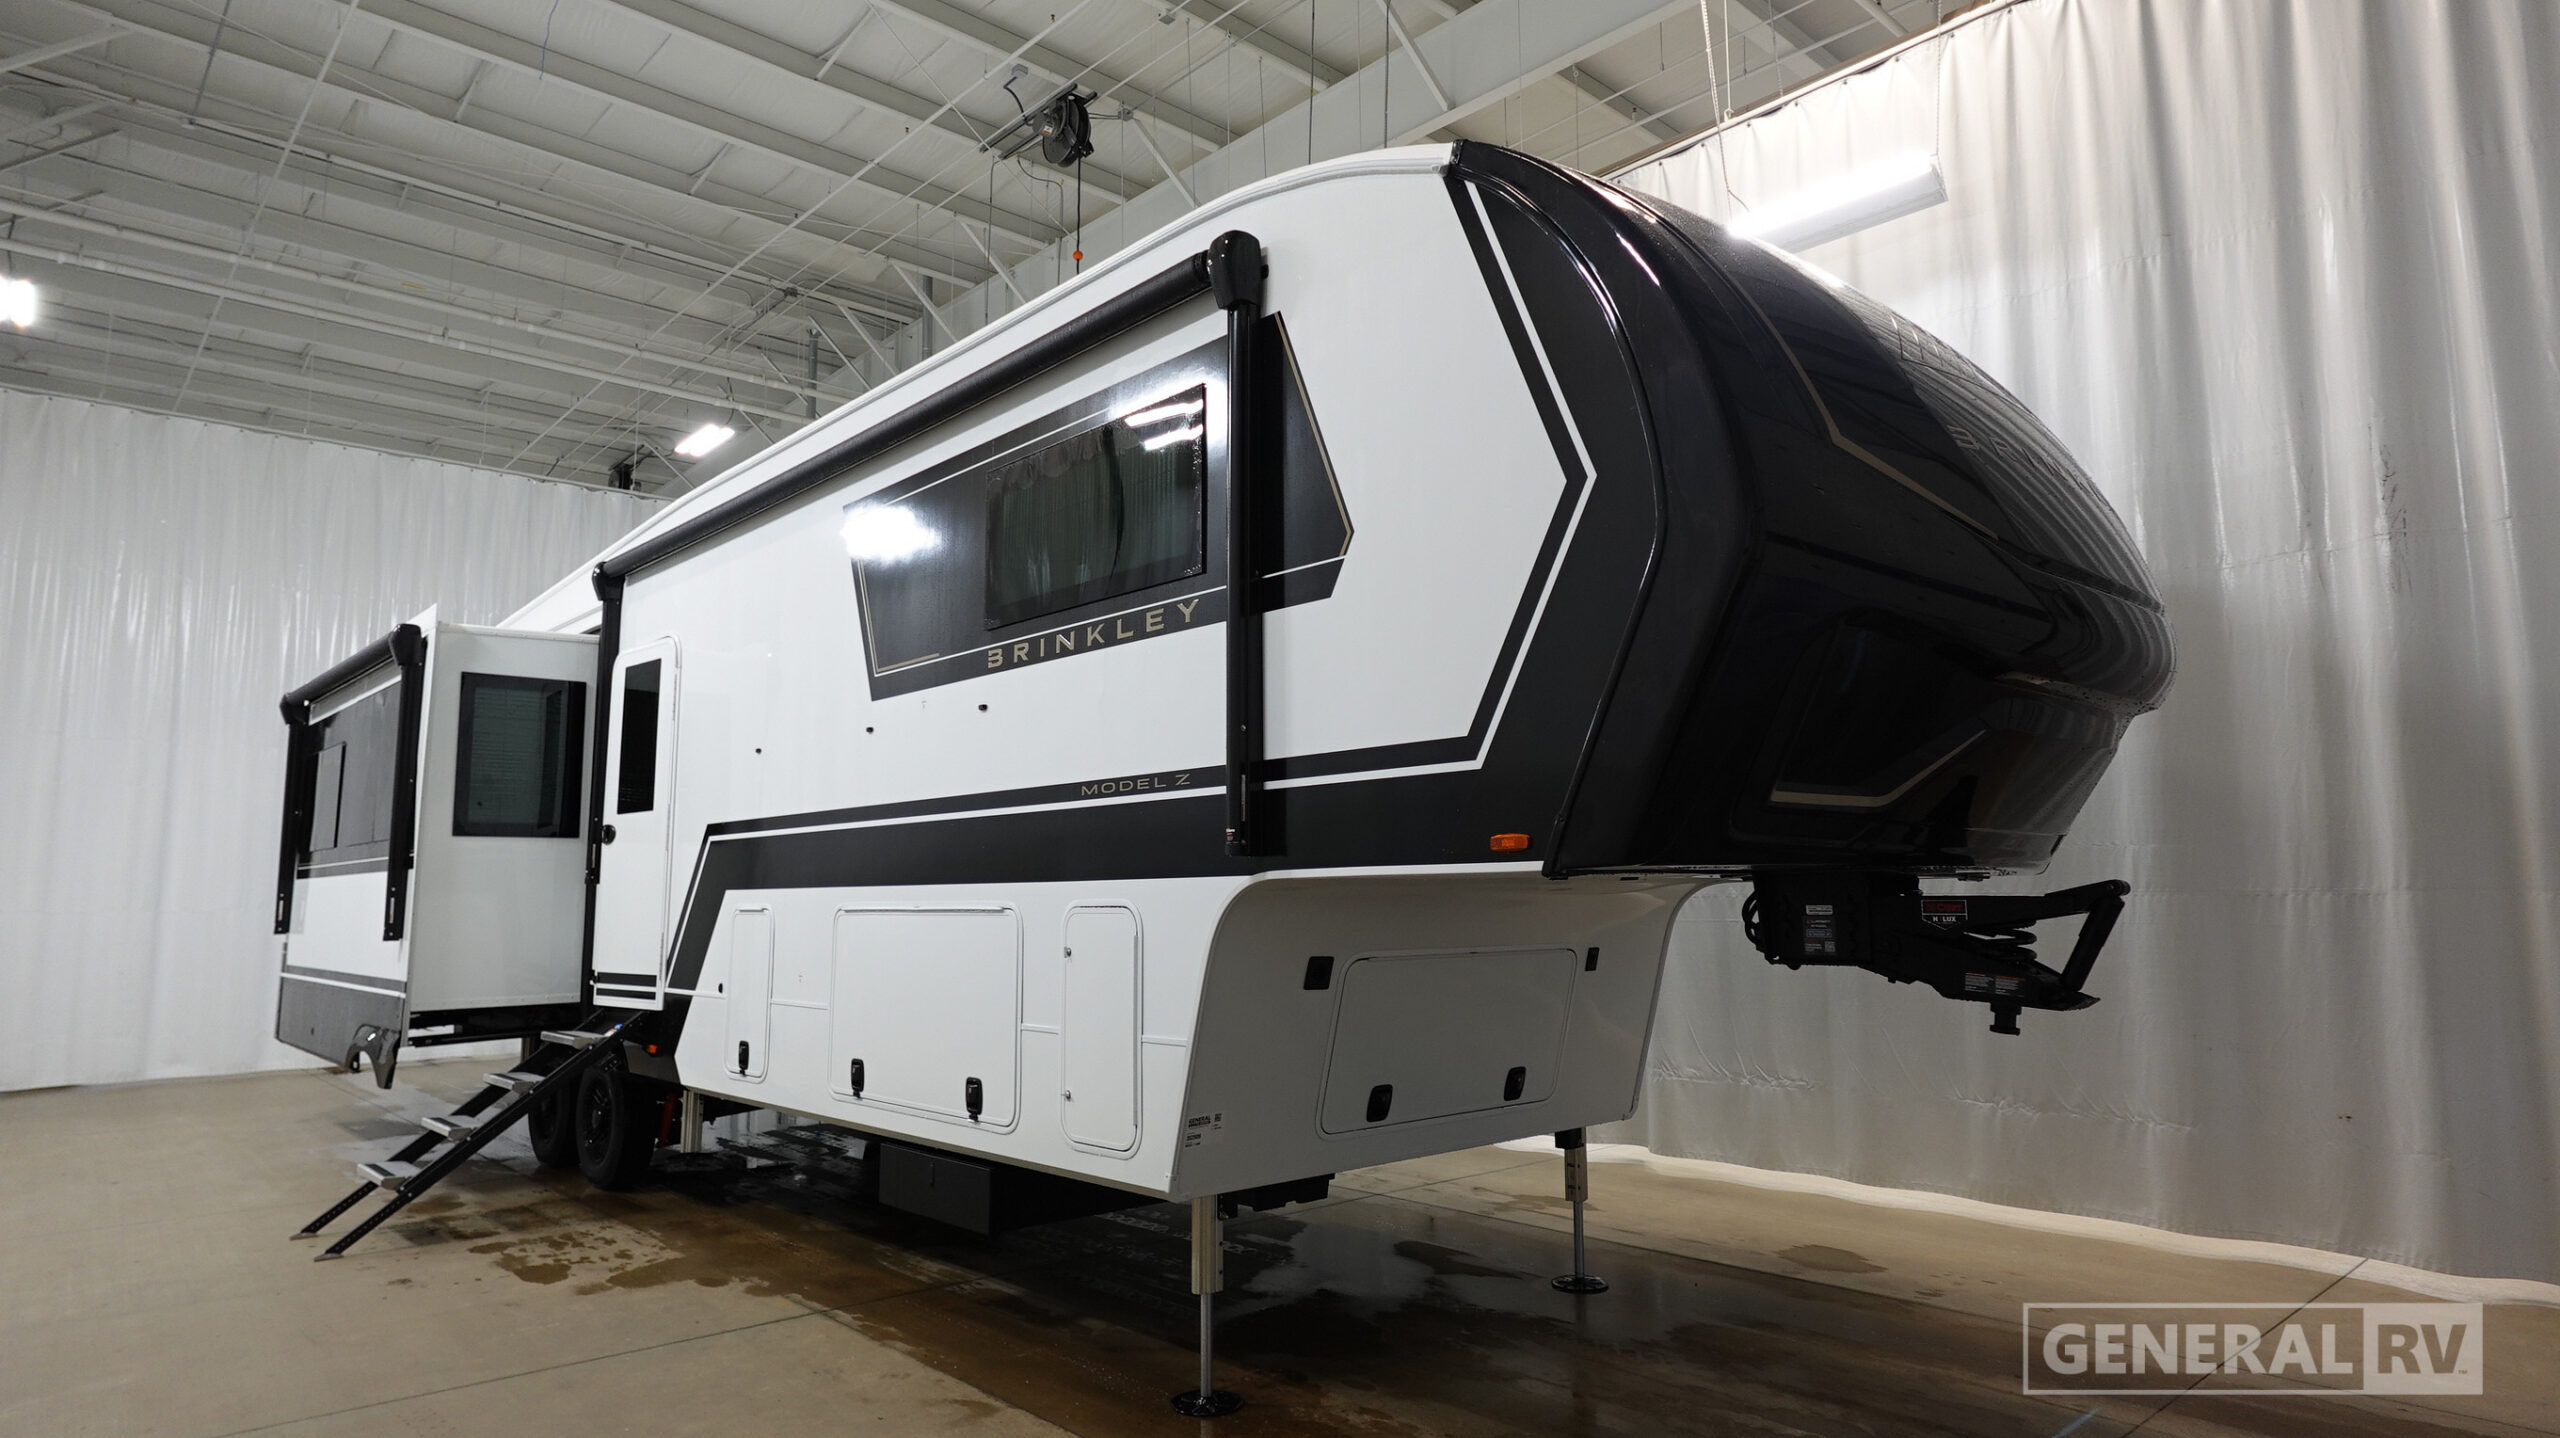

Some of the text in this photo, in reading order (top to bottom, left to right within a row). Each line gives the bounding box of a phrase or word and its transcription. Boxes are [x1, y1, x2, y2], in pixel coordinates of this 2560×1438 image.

[988, 598, 1200, 669] BRINKLEY
[1080, 772, 1192, 797] MODEL Z
